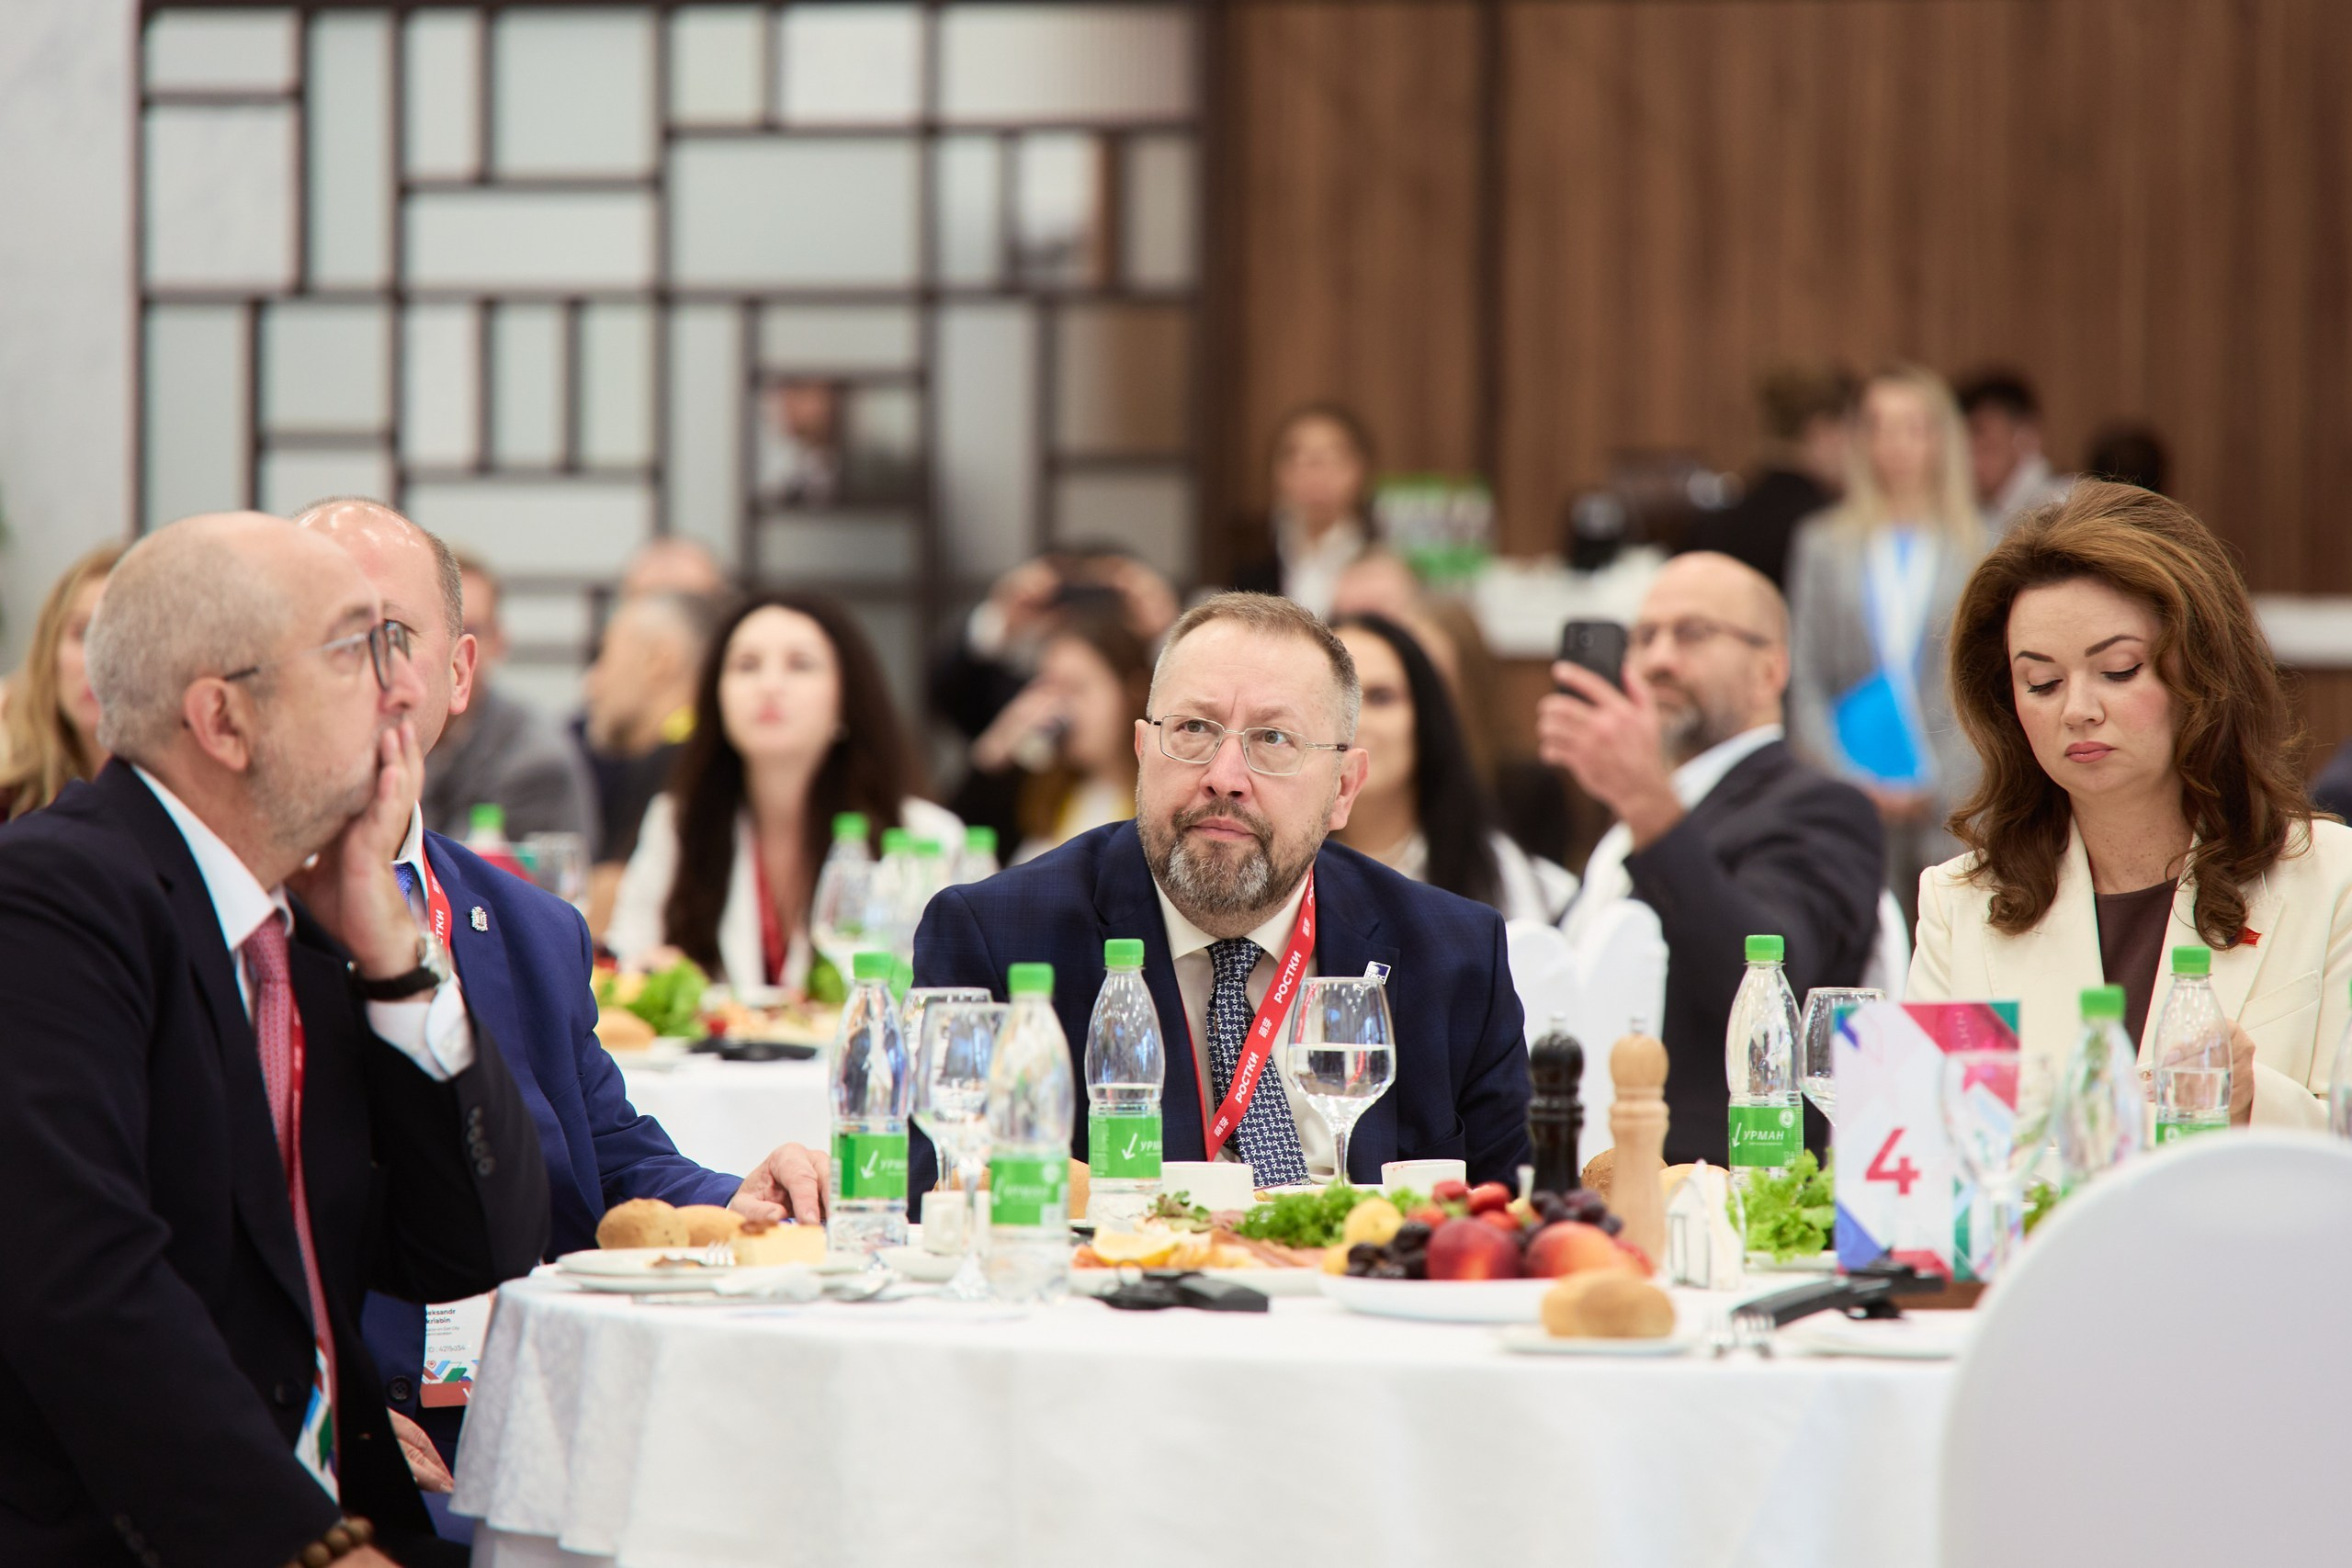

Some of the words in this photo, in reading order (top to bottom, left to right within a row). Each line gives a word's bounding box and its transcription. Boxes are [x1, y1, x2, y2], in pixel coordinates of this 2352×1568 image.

[1273, 950, 1302, 1004] РОСТКИ
[1234, 1051, 1260, 1104] РОСТКИ
[1743, 1130, 1784, 1141] УРМАН
[1864, 1127, 1921, 1196] 4
